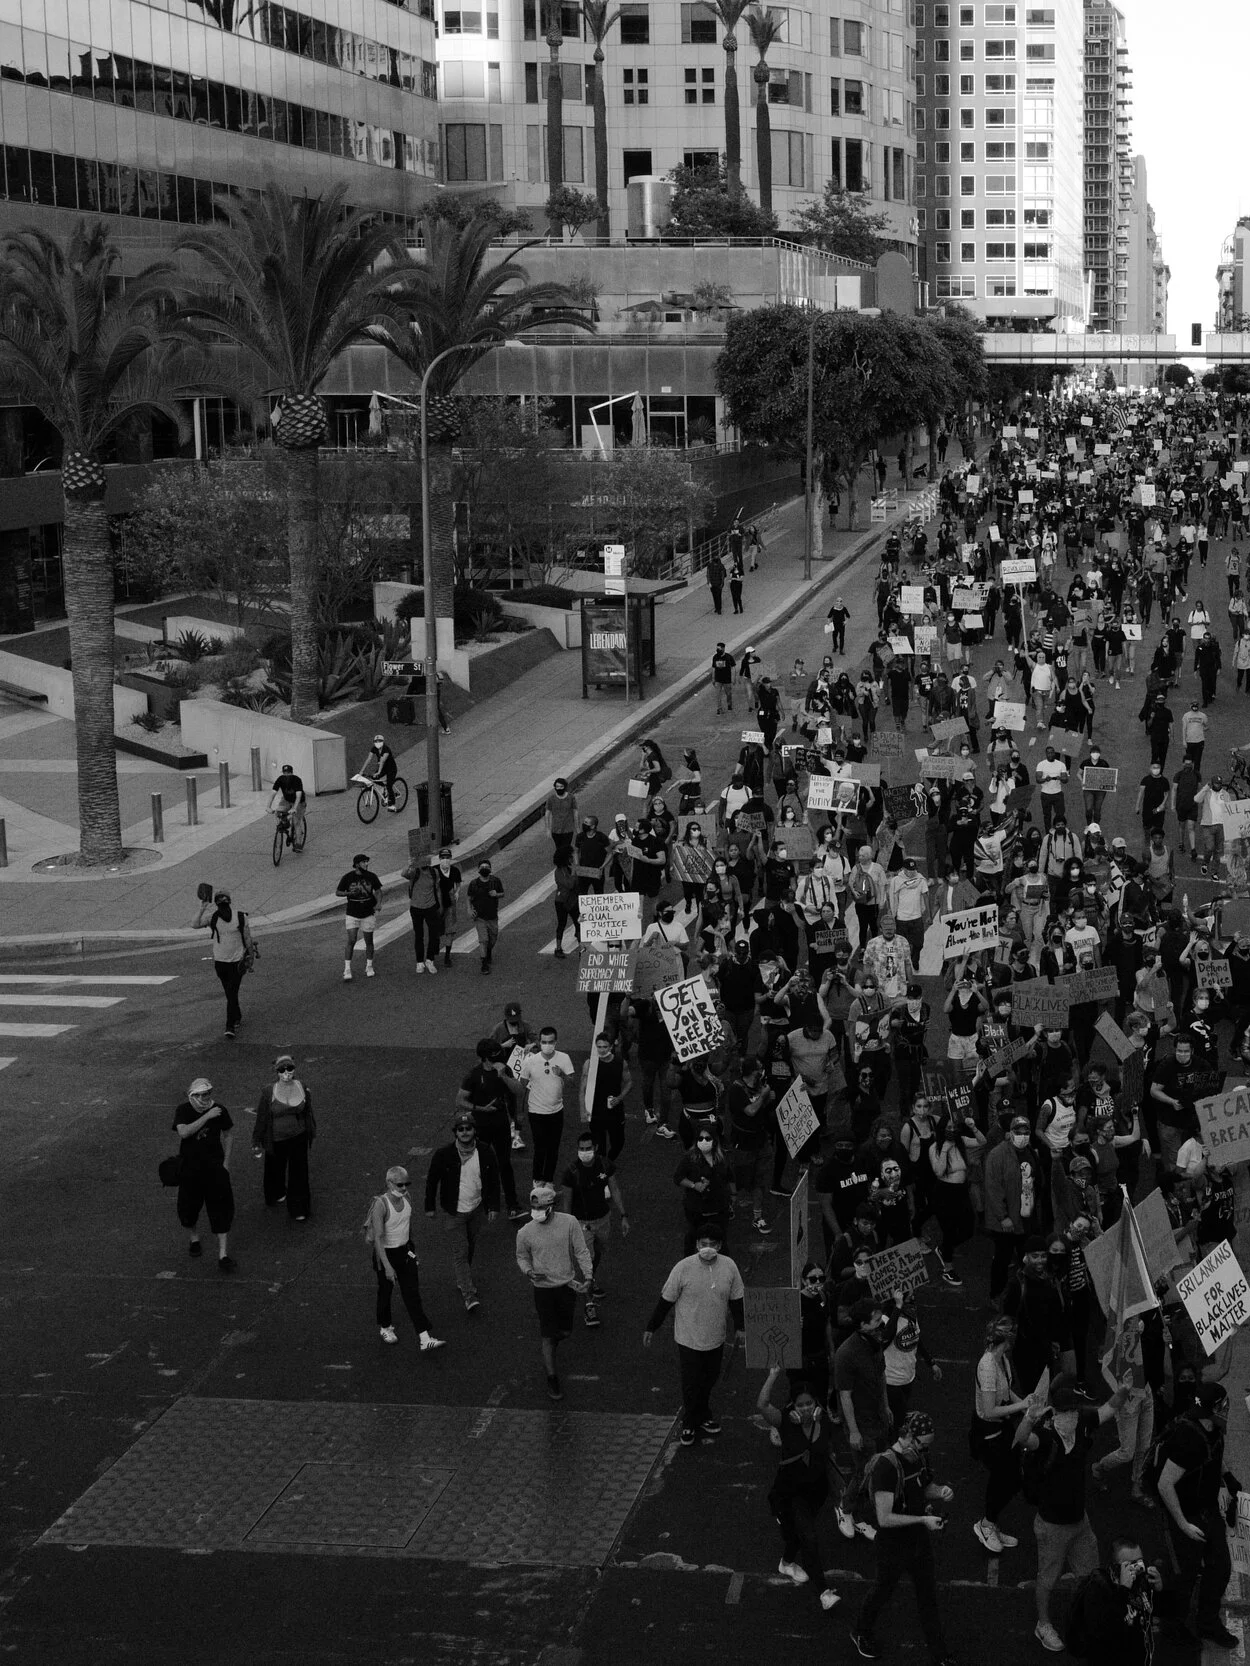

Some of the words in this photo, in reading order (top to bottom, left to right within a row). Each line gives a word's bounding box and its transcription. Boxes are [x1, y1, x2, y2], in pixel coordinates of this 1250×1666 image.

[590, 633, 627, 649] LEGENDARY
[413, 662, 422, 671] St
[581, 896, 624, 906] REMEMBER
[590, 904, 610, 913] YOUR
[613, 903, 635, 911] OATH!
[581, 913, 613, 921] EQUAL
[945, 918, 978, 933] You're
[980, 910, 997, 926] Not
[592, 920, 628, 929] JUSTICE
[586, 930, 602, 938] FOR
[605, 928, 623, 938] ALL!
[945, 934, 967, 948] Above
[588, 953, 604, 966] END
[609, 953, 630, 966] WHITE
[580, 968, 614, 980] SUPREMACY
[618, 968, 626, 979] IN
[1198, 962, 1228, 973] Defund
[579, 980, 591, 992] THE
[594, 980, 611, 992] WHITE
[613, 979, 634, 992] HOUSE
[1202, 977, 1230, 987] Police
[660, 979, 701, 1012] GET
[1012, 995, 1040, 1011] BLACK
[1041, 999, 1069, 1012] LIVES
[672, 1002, 717, 1031] YOUR
[673, 1024, 703, 1046] KNEE
[984, 1024, 1004, 1037] Black
[680, 1045, 701, 1058] OUR
[948, 1088, 959, 1099] WE
[960, 1085, 971, 1095] ALL
[1203, 1103, 1217, 1122] I
[868, 1249, 901, 1272] THERE
[869, 1261, 898, 1284] COMES
[898, 1257, 907, 1269] A
[1178, 1277, 1197, 1301] SRI
[1192, 1242, 1232, 1286] LANKANS
[1203, 1282, 1225, 1306] FOR
[1195, 1302, 1225, 1336] BLACK
[1222, 1279, 1248, 1310] LIVES
[1209, 1300, 1248, 1344] MATTER
